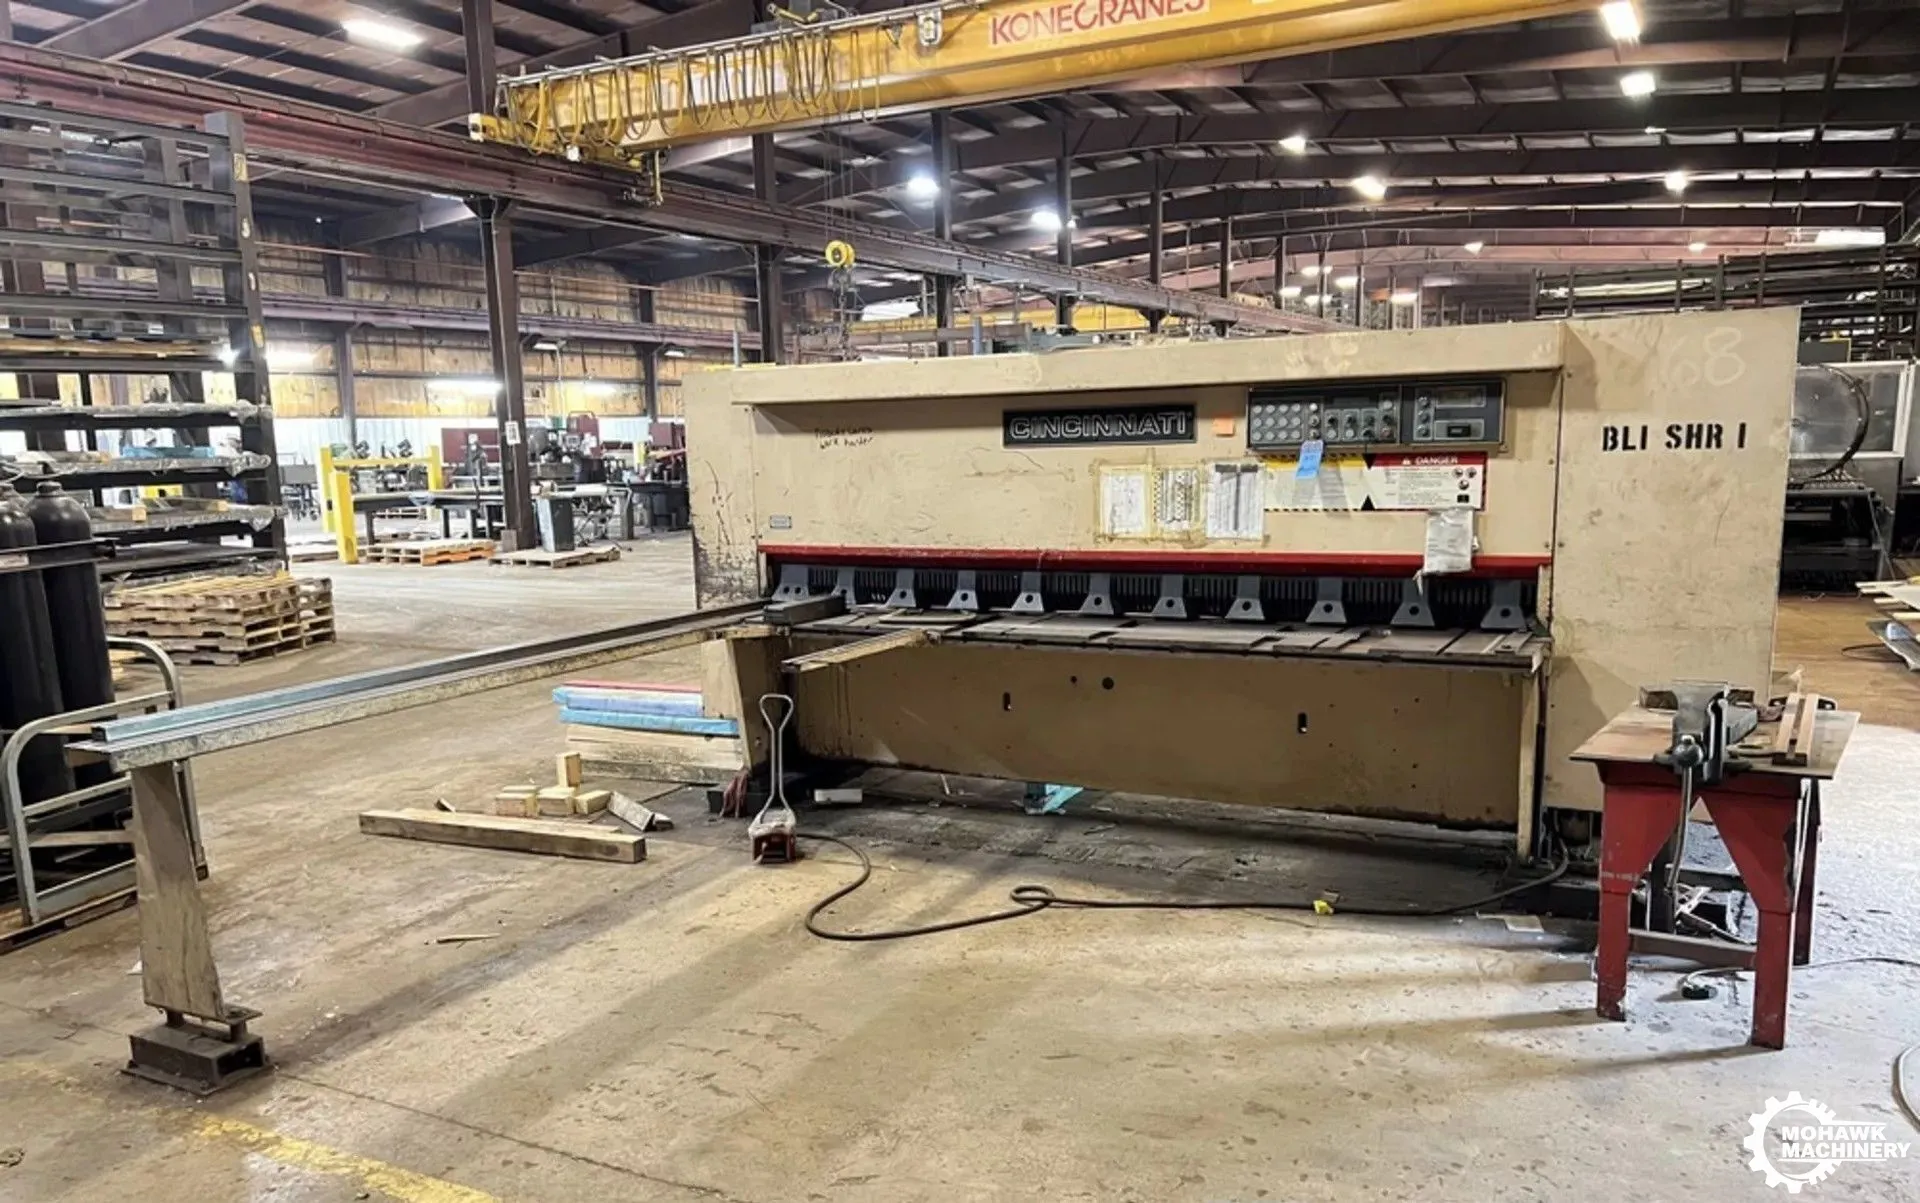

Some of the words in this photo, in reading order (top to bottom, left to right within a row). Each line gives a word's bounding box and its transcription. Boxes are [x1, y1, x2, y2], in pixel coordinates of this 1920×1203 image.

[1010, 411, 1187, 439] CINCINNATI
[1665, 423, 1723, 450] SHR
[1415, 456, 1458, 466] DANGER
